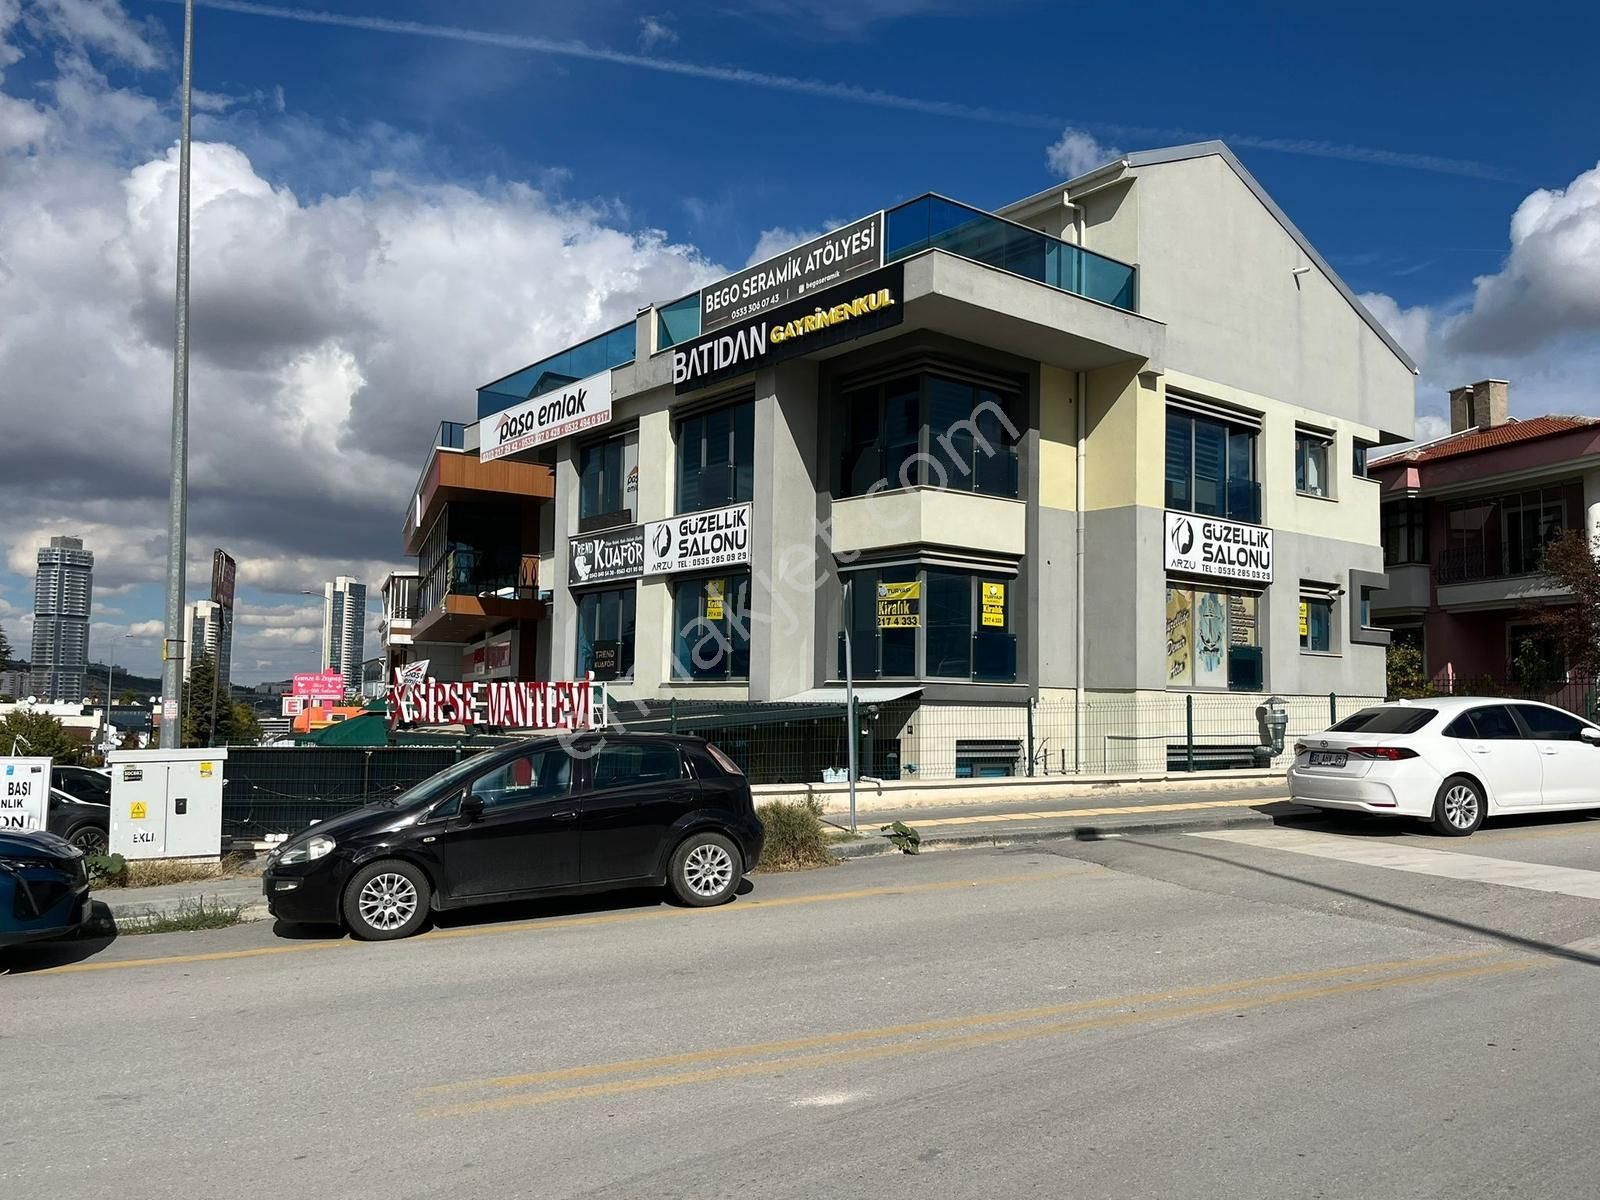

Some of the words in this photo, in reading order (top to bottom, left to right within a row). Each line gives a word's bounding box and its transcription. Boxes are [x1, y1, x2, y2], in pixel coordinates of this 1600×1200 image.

[706, 284, 740, 313] BEGO
[742, 256, 802, 298] SERAMİK
[804, 222, 875, 274] ATÖLYESİ
[805, 271, 841, 289] begoseramik
[731, 306, 747, 319] 0533
[748, 301, 760, 313] 306
[761, 298, 770, 308] 07
[770, 293, 780, 304] 43
[672, 322, 766, 384] BATIDAN
[770, 288, 895, 343] GAYRİMENKUL
[499, 410, 534, 444] paşa
[538, 388, 587, 426] emlak
[564, 421, 579, 433] 0532
[596, 412, 608, 422] 917
[678, 529, 747, 558] SALONU
[570, 541, 593, 556] TREND
[593, 539, 643, 569] KUAFÖR
[692, 557, 710, 566] 0535
[711, 555, 724, 563] 285
[727, 553, 736, 561] 09
[737, 552, 747, 560] 29
[1202, 542, 1270, 570] SALONU
[652, 561, 673, 571] ARZU
[1171, 559, 1196, 569] ARZU
[1218, 566, 1236, 576] 0535
[1237, 569, 1250, 577] 285
[1252, 570, 1260, 578] 09
[878, 600, 910, 615] Kiralık
[877, 617, 891, 626] 217
[894, 617, 899, 625] 4
[901, 616, 918, 625] 333
[8, 781, 31, 797] BAŞI
